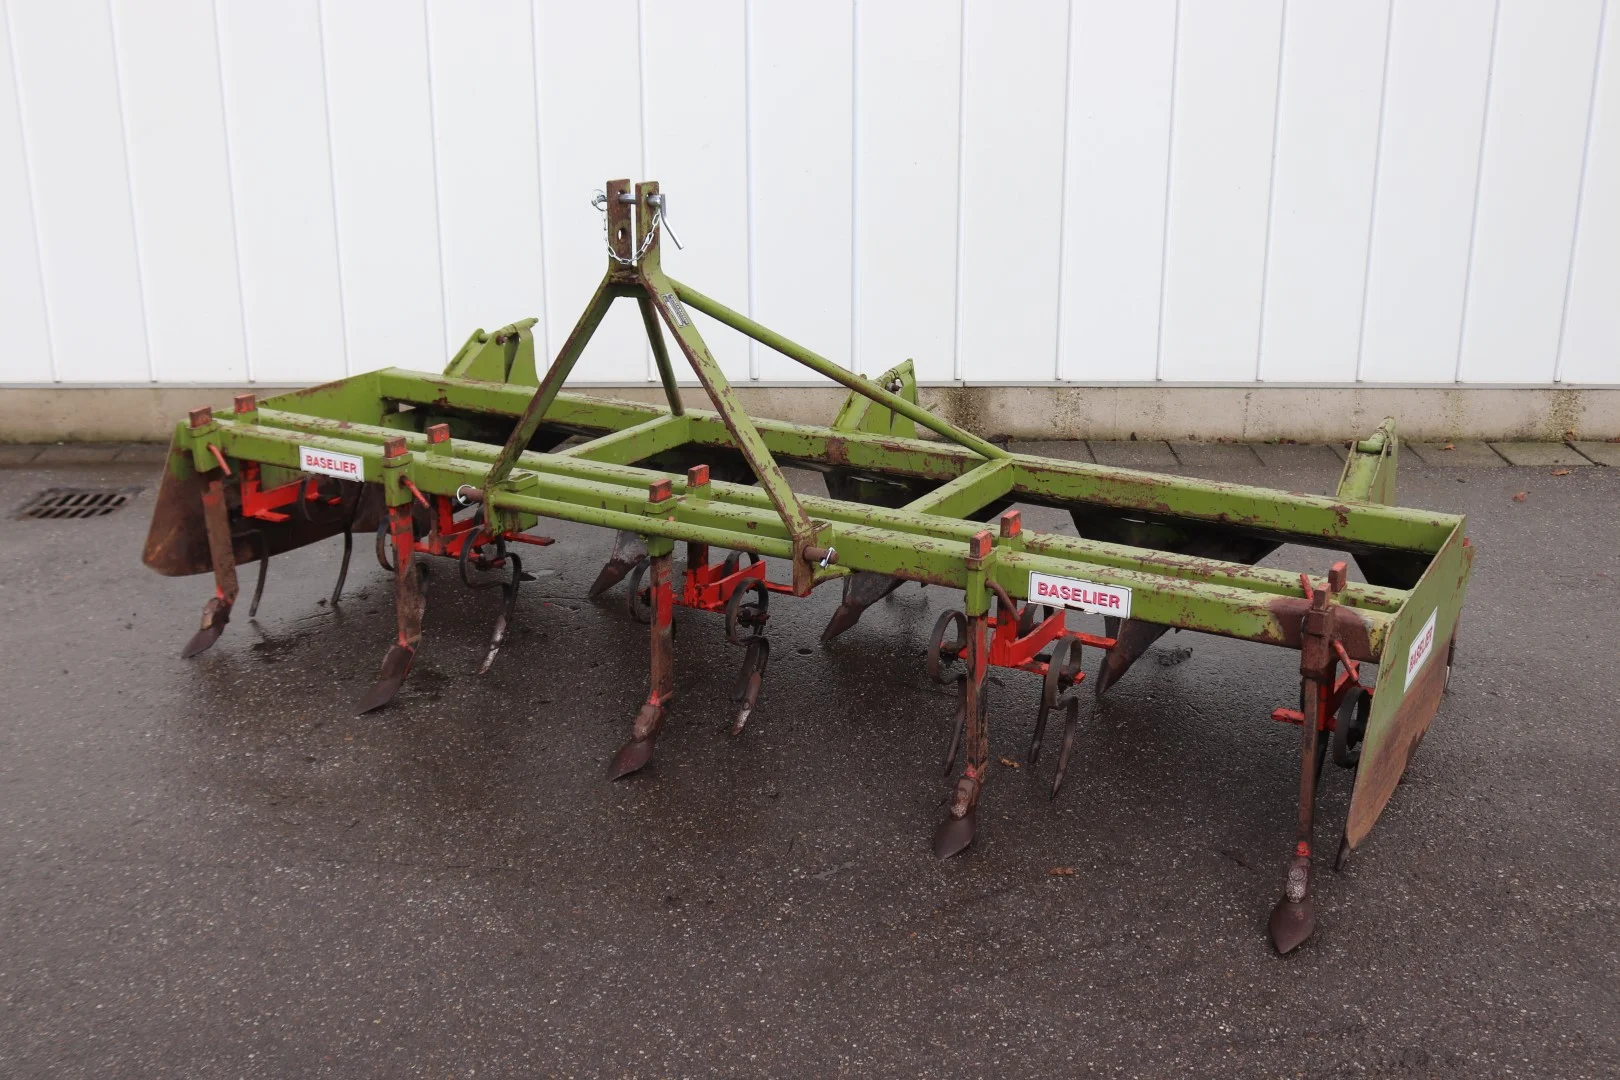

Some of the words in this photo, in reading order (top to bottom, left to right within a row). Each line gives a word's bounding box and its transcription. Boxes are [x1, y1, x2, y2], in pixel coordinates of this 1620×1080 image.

[306, 455, 357, 474] BASELIER
[1037, 581, 1121, 609] BASELIER
[1408, 625, 1433, 674] BASELIER
